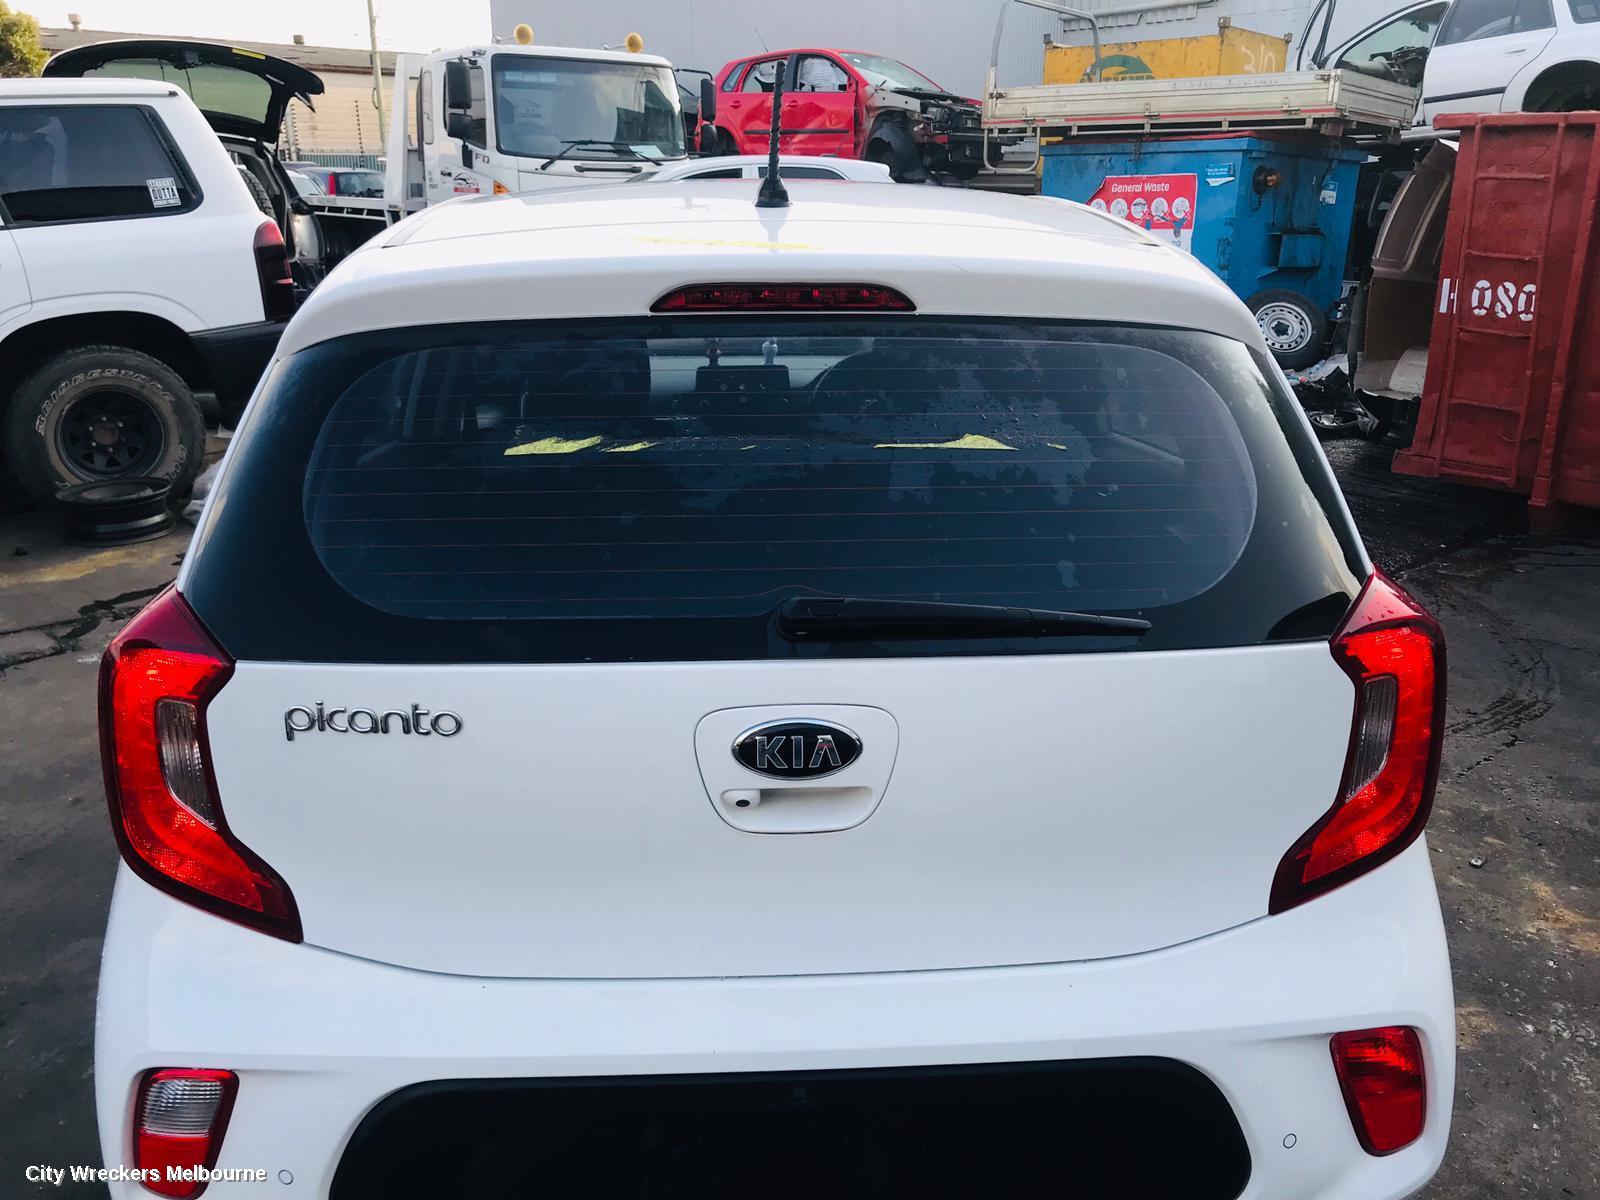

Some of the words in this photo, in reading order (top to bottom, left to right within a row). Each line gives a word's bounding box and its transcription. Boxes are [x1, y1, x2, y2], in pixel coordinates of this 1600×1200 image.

[151, 187, 178, 200] OUTTA
[1111, 182, 1143, 193] General
[1144, 182, 1170, 193] Waste
[284, 700, 463, 741] picanto
[755, 734, 842, 768] KIA
